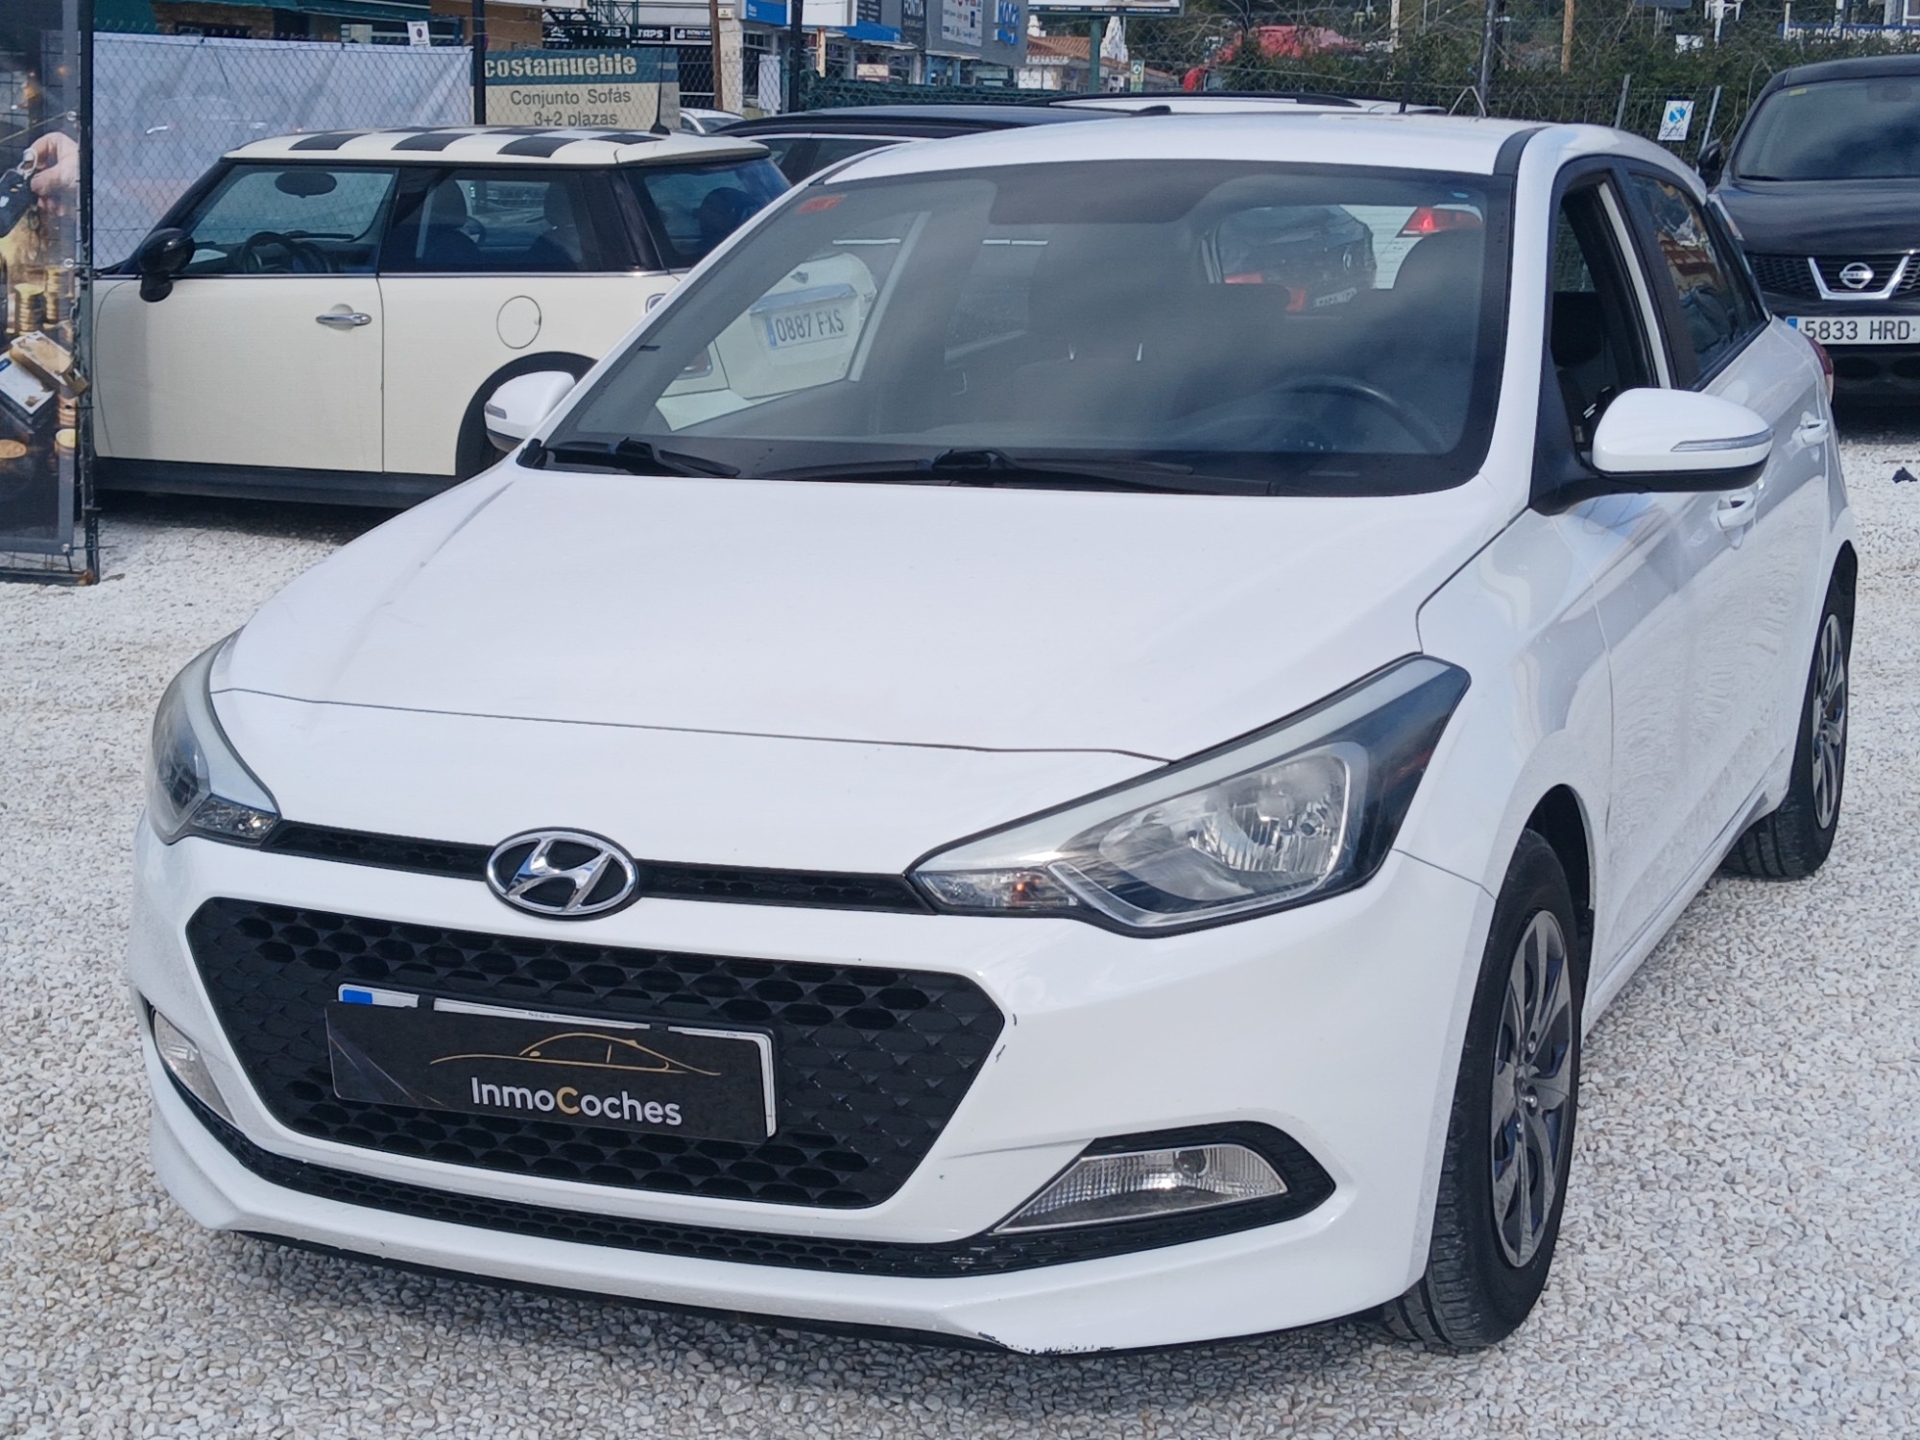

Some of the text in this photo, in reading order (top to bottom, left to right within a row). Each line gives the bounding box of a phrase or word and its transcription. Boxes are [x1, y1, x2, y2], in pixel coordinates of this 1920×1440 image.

[484, 53, 638, 78] costamueble
[510, 88, 632, 108] Conjunto Sofás
[533, 111, 618, 127] 3+2 plazas
[775, 309, 844, 342] 0887 FXS
[1804, 320, 1910, 341] 5833 HRD
[470, 1076, 683, 1127] InmoCoches
